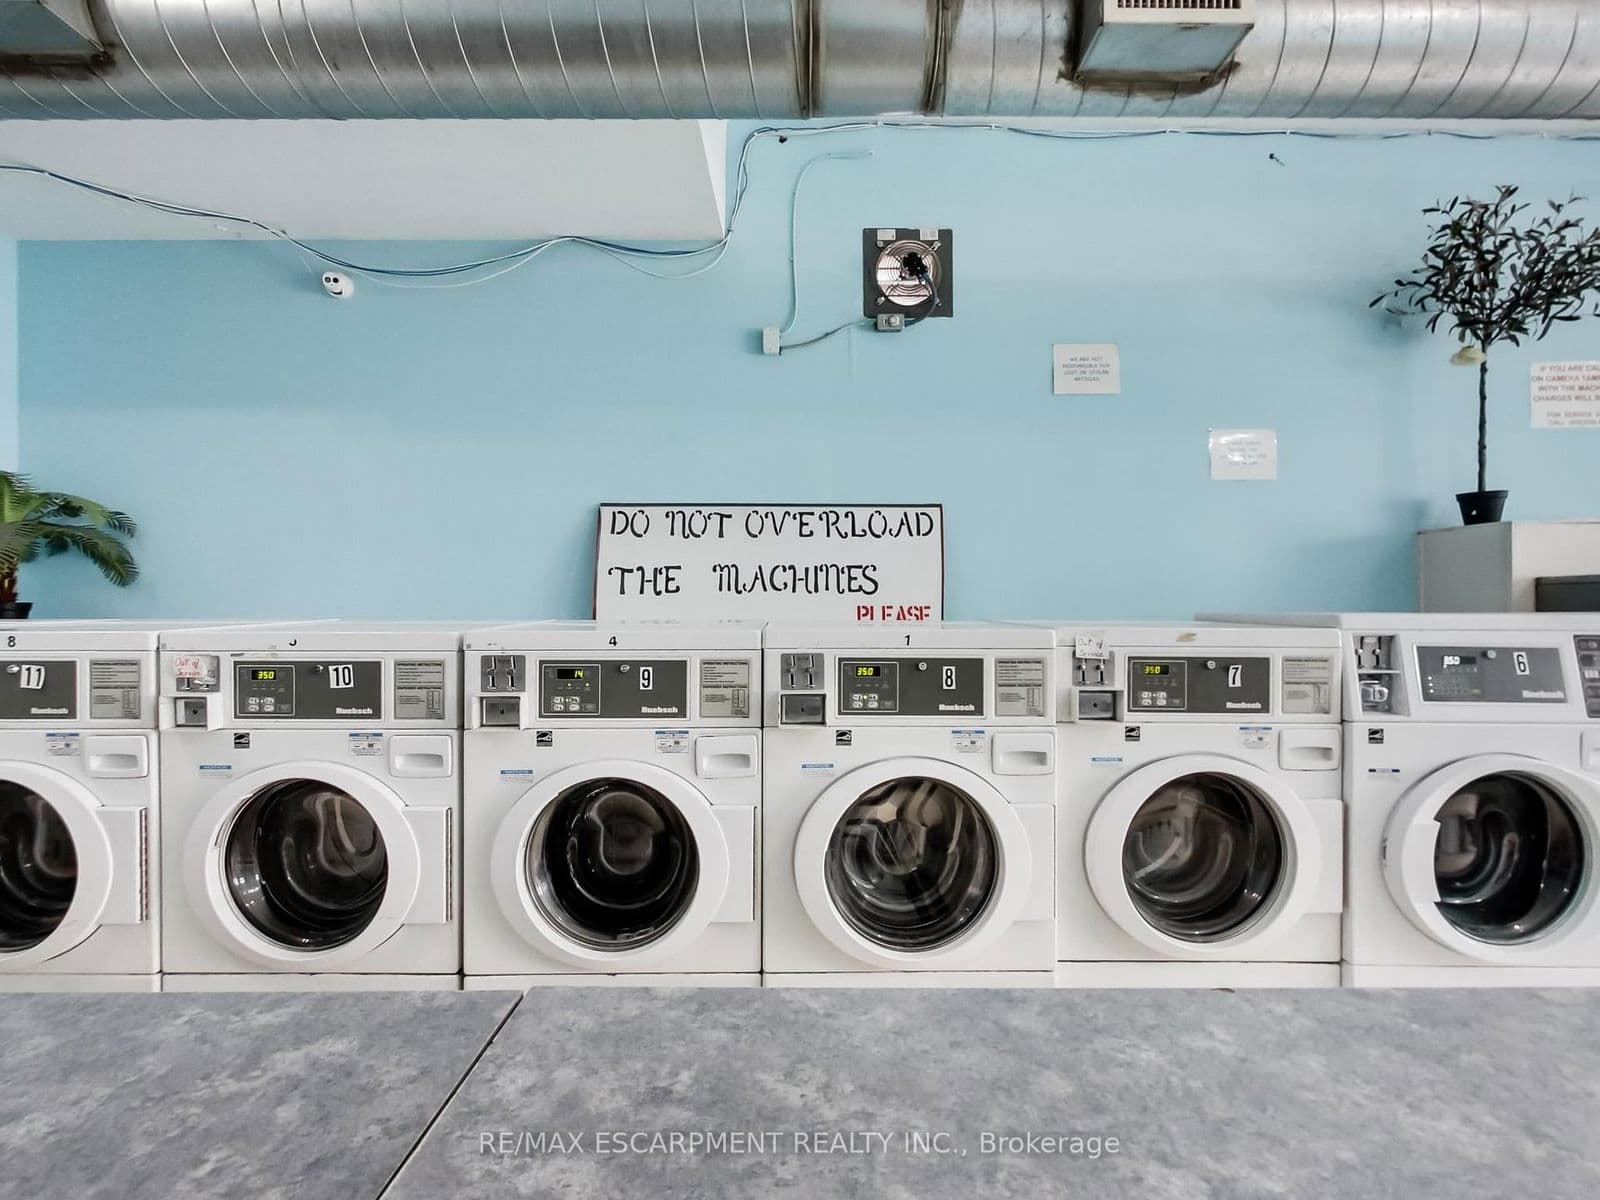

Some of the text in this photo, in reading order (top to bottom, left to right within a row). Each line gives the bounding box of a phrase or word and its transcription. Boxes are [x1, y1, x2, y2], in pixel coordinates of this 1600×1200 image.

[610, 511, 933, 539] DO NOT OVERLOAD
[608, 564, 879, 596] THE MACHINES
[8, 635, 16, 647] 8
[608, 636, 618, 647] 4
[904, 634, 911, 646] 1
[857, 667, 874, 676] 350
[1144, 665, 1161, 674] 350
[1517, 654, 1527, 673] 6
[24, 666, 42, 687] 11
[257, 671, 274, 679] 350
[332, 666, 352, 686] 10
[575, 670, 583, 678] 14
[641, 668, 651, 688] 9
[945, 668, 953, 687] 8
[1231, 666, 1239, 685] 7
